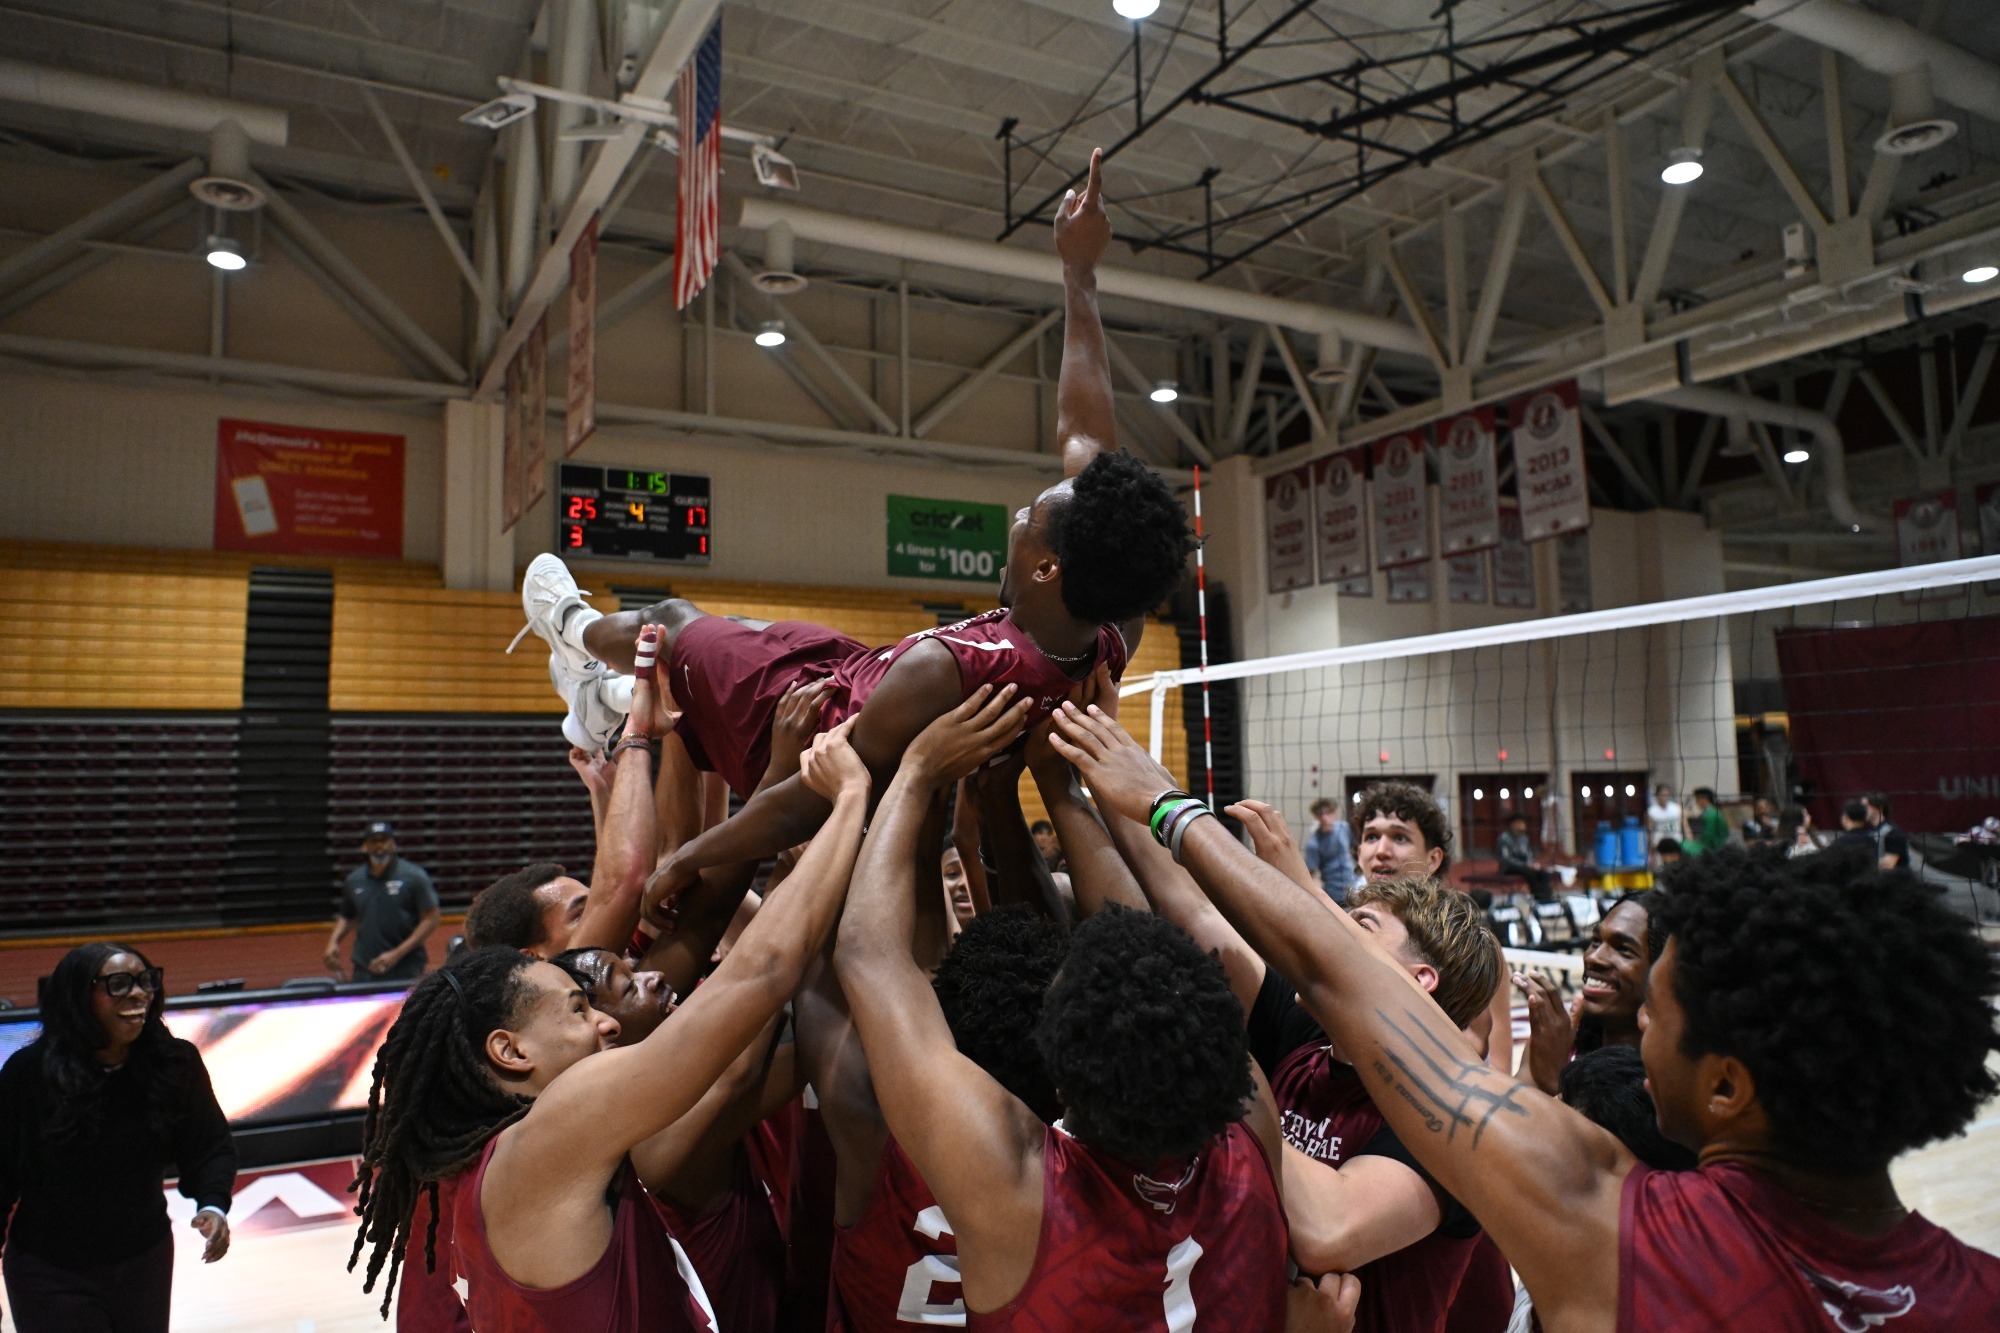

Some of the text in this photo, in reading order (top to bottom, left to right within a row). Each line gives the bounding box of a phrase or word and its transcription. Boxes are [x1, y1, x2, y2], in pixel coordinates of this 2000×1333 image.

[235, 431, 321, 450] McDonald's
[1527, 447, 1570, 475] 2013
[626, 471, 667, 494] 1:15
[568, 496, 597, 520] 25
[674, 495, 708, 506] GUEST
[629, 502, 644, 523] 4
[687, 506, 707, 527] 17
[569, 524, 583, 548] 3
[699, 535, 707, 554] 1
[895, 542, 937, 558] 4 lines
[918, 560, 937, 574] for
[1163, 1235, 1202, 1333] 1
